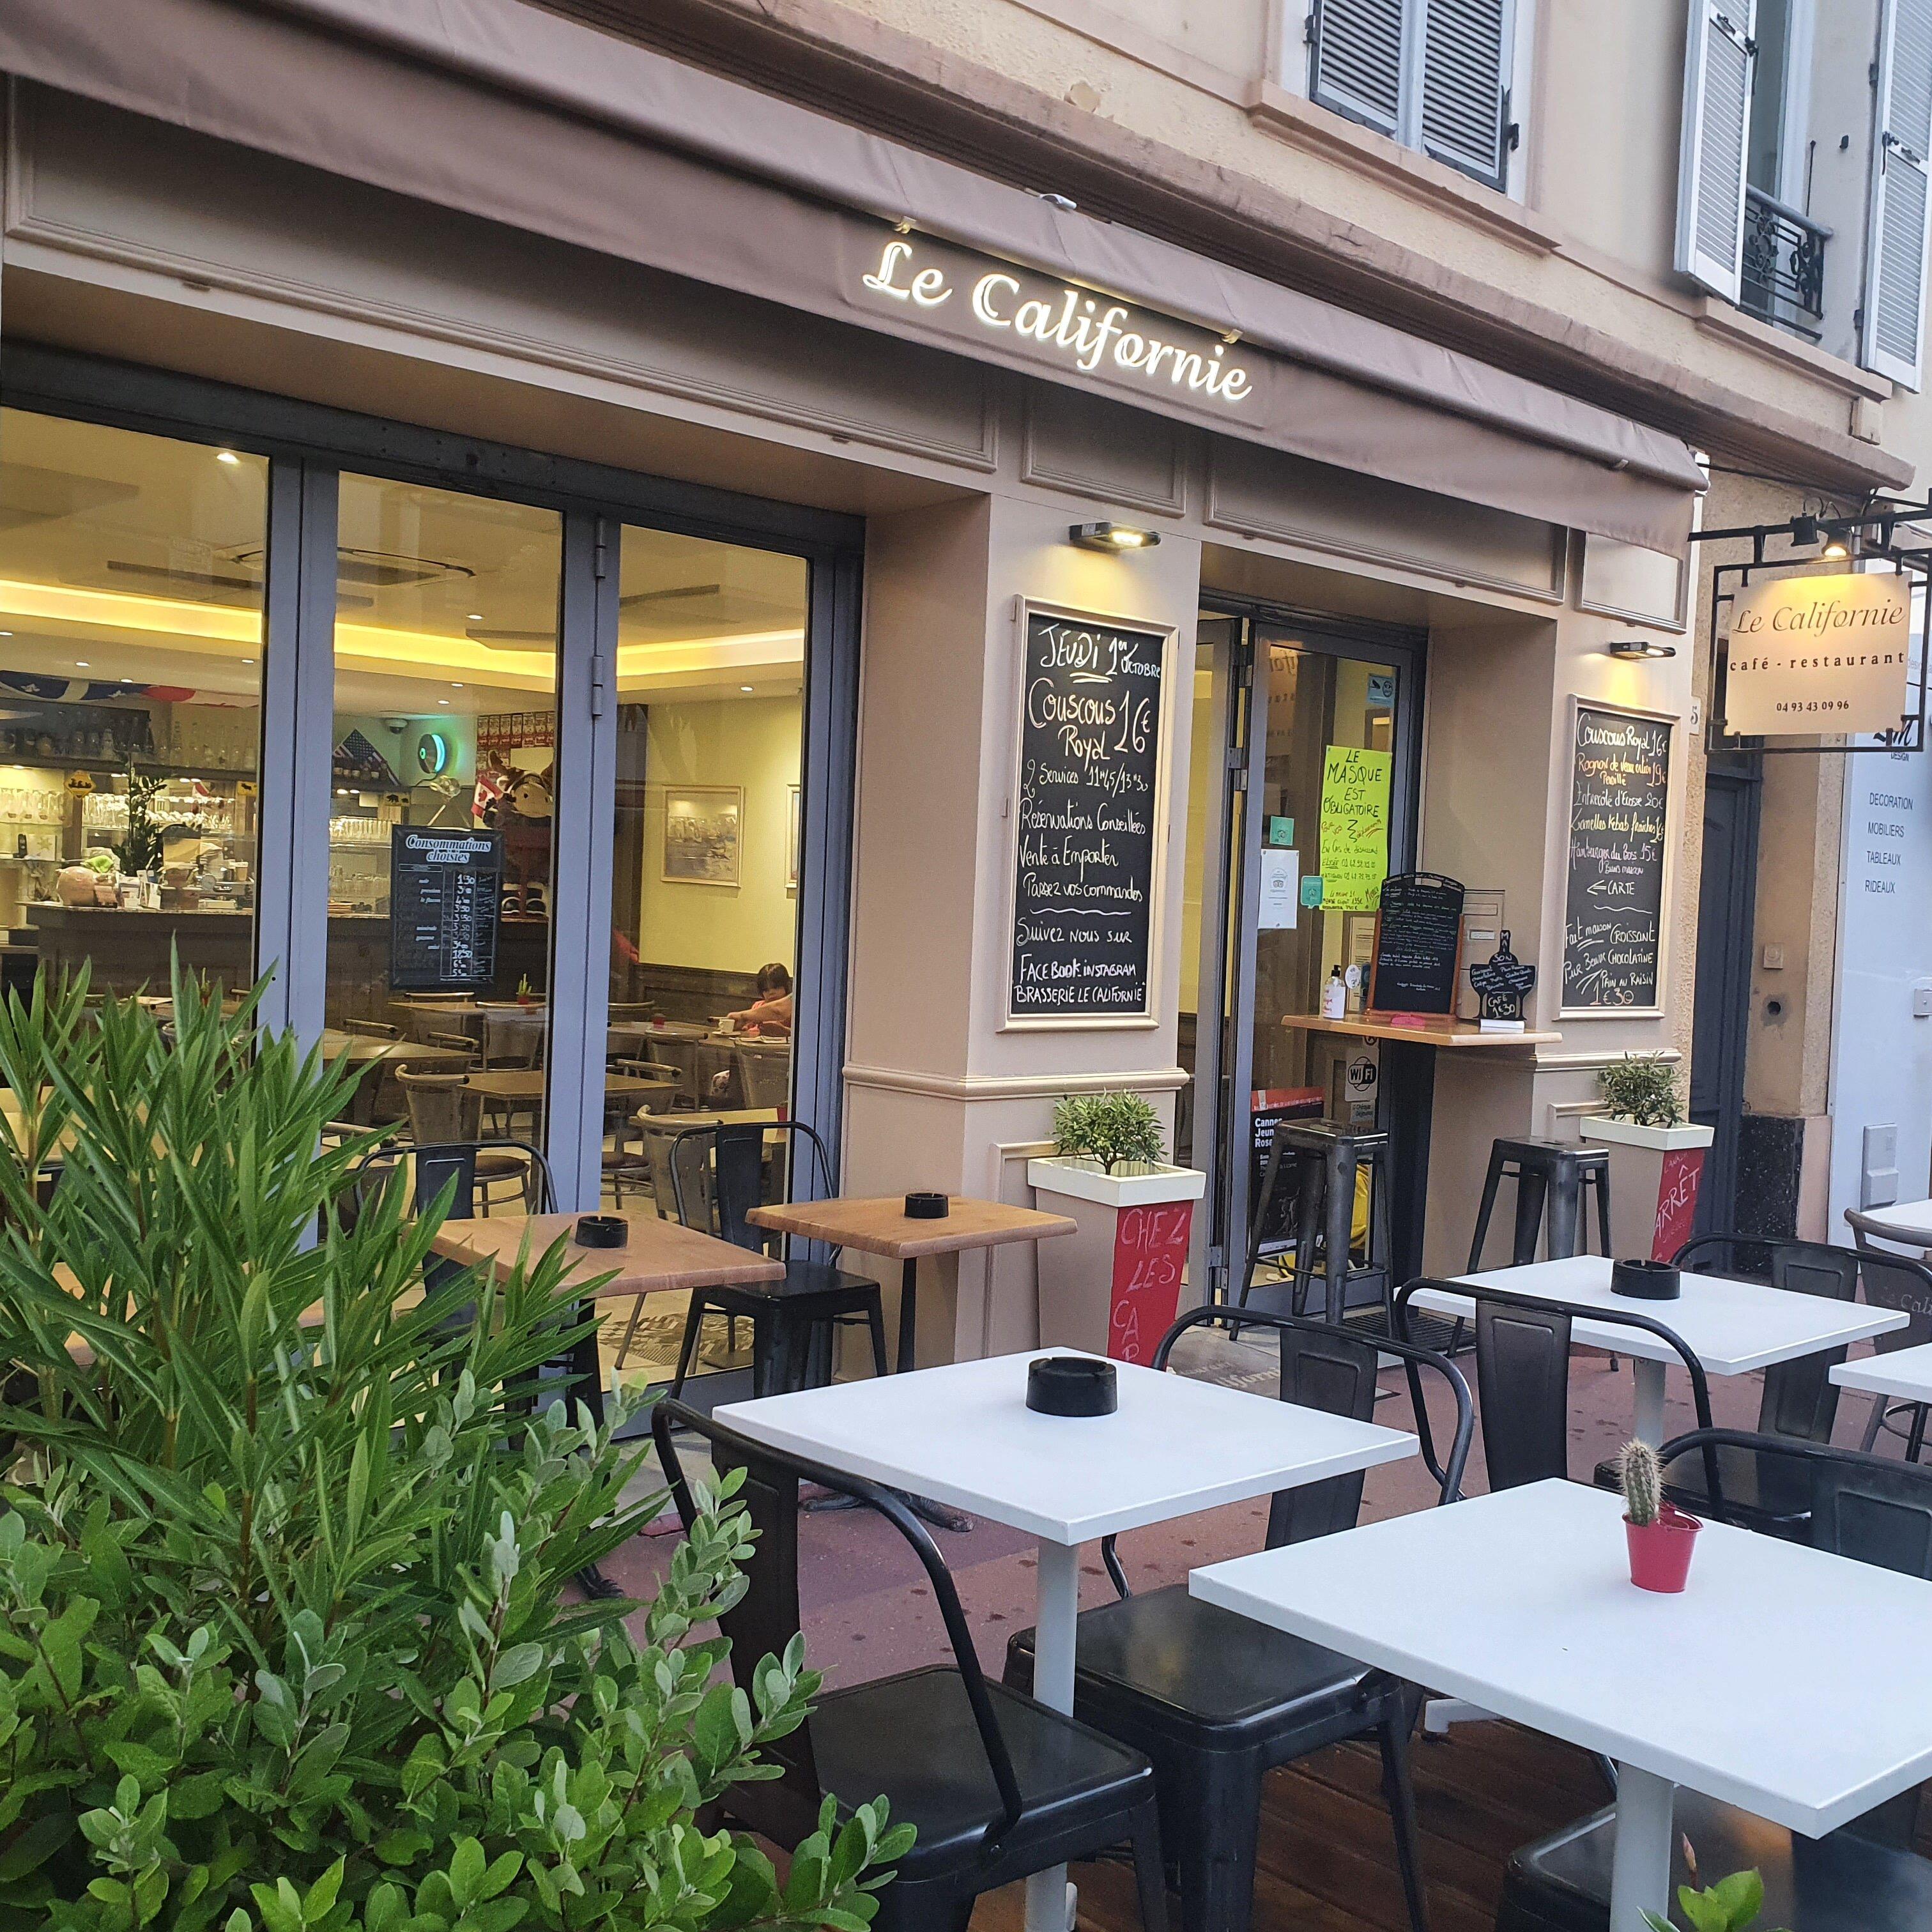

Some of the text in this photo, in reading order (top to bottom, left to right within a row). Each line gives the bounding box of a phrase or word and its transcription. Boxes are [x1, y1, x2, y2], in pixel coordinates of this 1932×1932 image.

[862, 241, 1252, 400] Le Californie
[1732, 599, 1906, 637] Le Californie
[1730, 657, 1769, 671] café
[1790, 652, 1905, 669] restaurant
[1029, 678, 1116, 728] Couscous
[1776, 700, 1850, 712] 04 93 43 09 96
[1690, 706, 1698, 724] 5
[1346, 749, 1360, 763] LE
[1327, 762, 1383, 785] MASQUE
[1344, 787, 1366, 801] EST
[1869, 792, 1913, 811] DECORATION
[1868, 822, 1904, 838] MOBILIERS
[406, 834, 491, 852] Consommations
[1020, 832, 1048, 868] Vente
[426, 850, 470, 863] choisies
[1867, 851, 1901, 866] TABLEAUX
[1608, 880, 1634, 894] CARTE
[1865, 880, 1896, 894] RIDEAUX
[1078, 988, 1089, 1002] LE
[1121, 1208, 1186, 1254] CHEZ
[1125, 1254, 1176, 1293] LES
